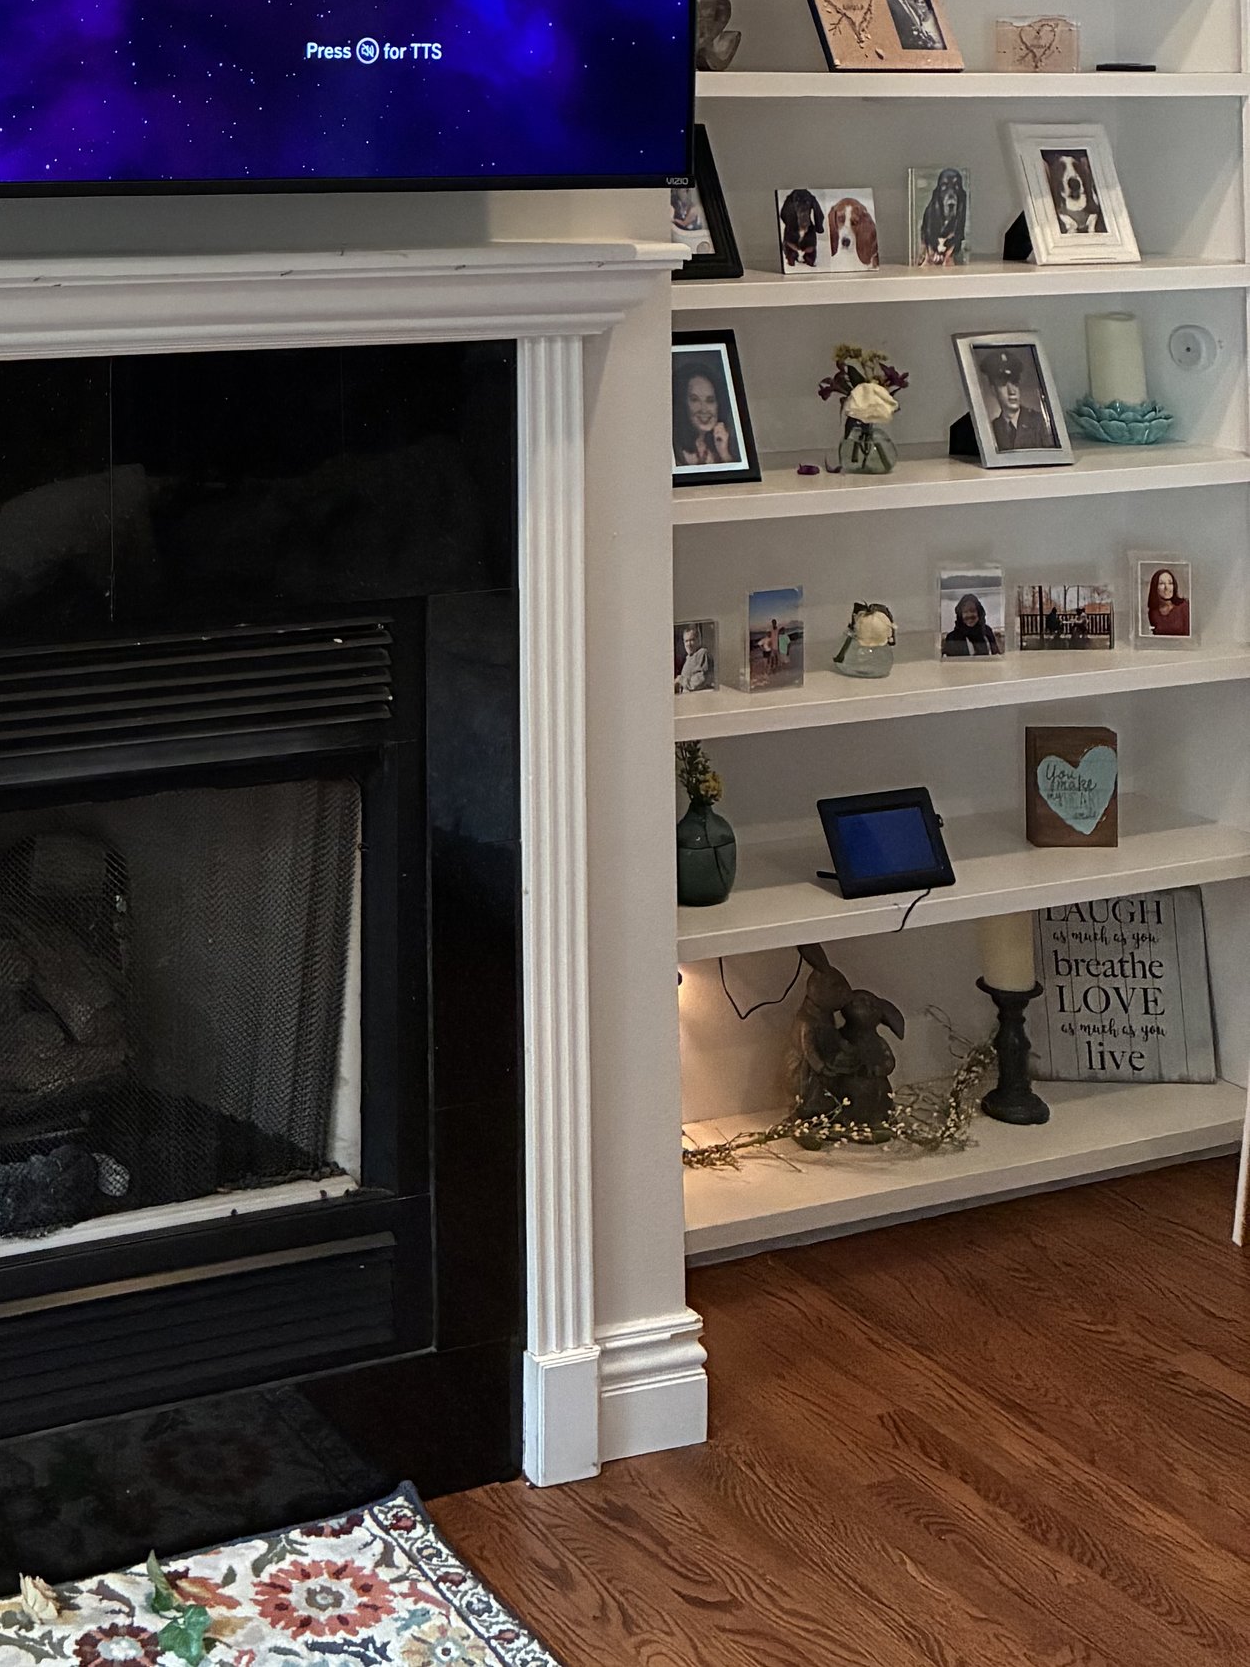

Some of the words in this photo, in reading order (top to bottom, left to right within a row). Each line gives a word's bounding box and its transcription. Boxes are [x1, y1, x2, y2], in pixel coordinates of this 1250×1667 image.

[306, 43, 352, 60] Press
[383, 42, 408, 60] for
[410, 42, 443, 60] TTS
[666, 177, 689, 185] VIZIO
[1045, 898, 1163, 925] LAUGH
[1052, 931, 1067, 944] as
[1071, 925, 1109, 946] much
[1113, 933, 1128, 946] as
[1132, 932, 1160, 950] you
[1053, 949, 1164, 980] breathe
[1056, 984, 1166, 1017] LOVE
[1060, 1021, 1075, 1036] as
[1079, 1017, 1118, 1037] much
[1121, 1025, 1136, 1038] as
[1140, 1025, 1166, 1043] you
[1085, 1040, 1145, 1072] live
